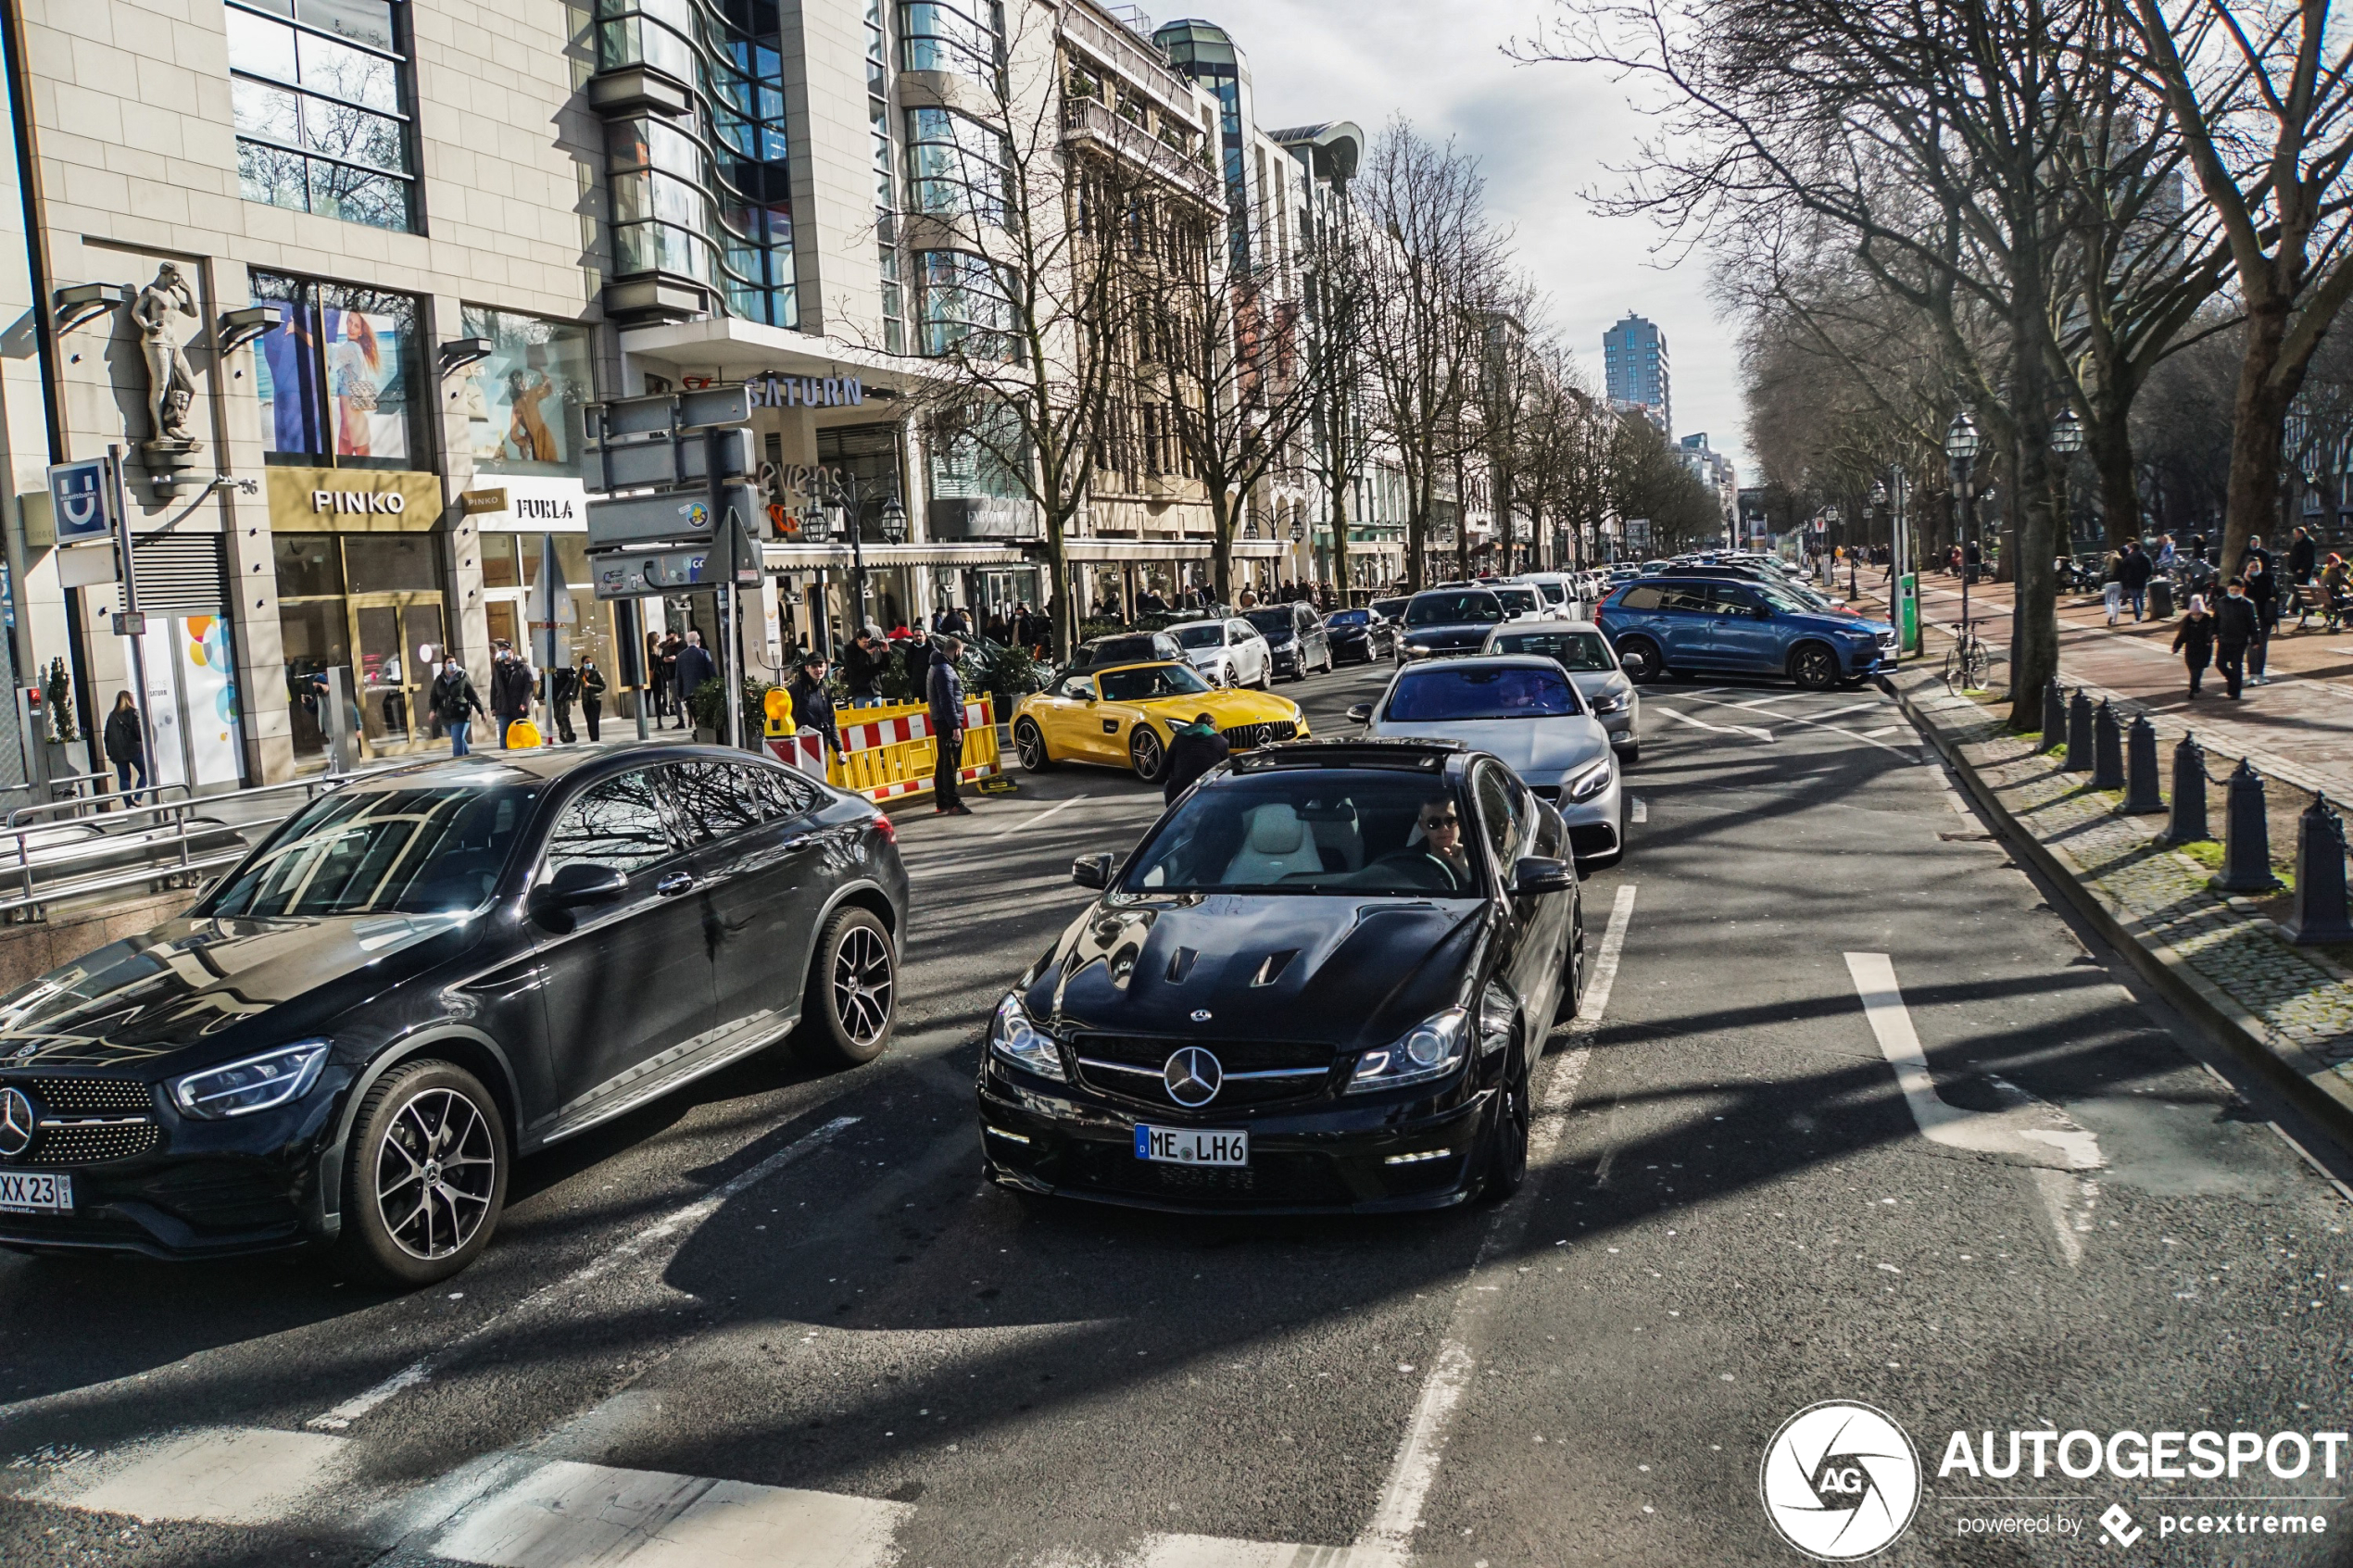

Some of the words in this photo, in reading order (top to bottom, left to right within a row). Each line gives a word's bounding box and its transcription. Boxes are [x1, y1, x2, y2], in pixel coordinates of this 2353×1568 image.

[745, 376, 862, 408] SATURN
[747, 461, 843, 500] evens
[59, 491, 97, 501] stadtbahn
[312, 490, 405, 514] PINKO
[469, 496, 498, 507] PINKO
[517, 499, 573, 519] FURLA
[1139, 1145, 1146, 1153] D
[1150, 1131, 1178, 1159] ME
